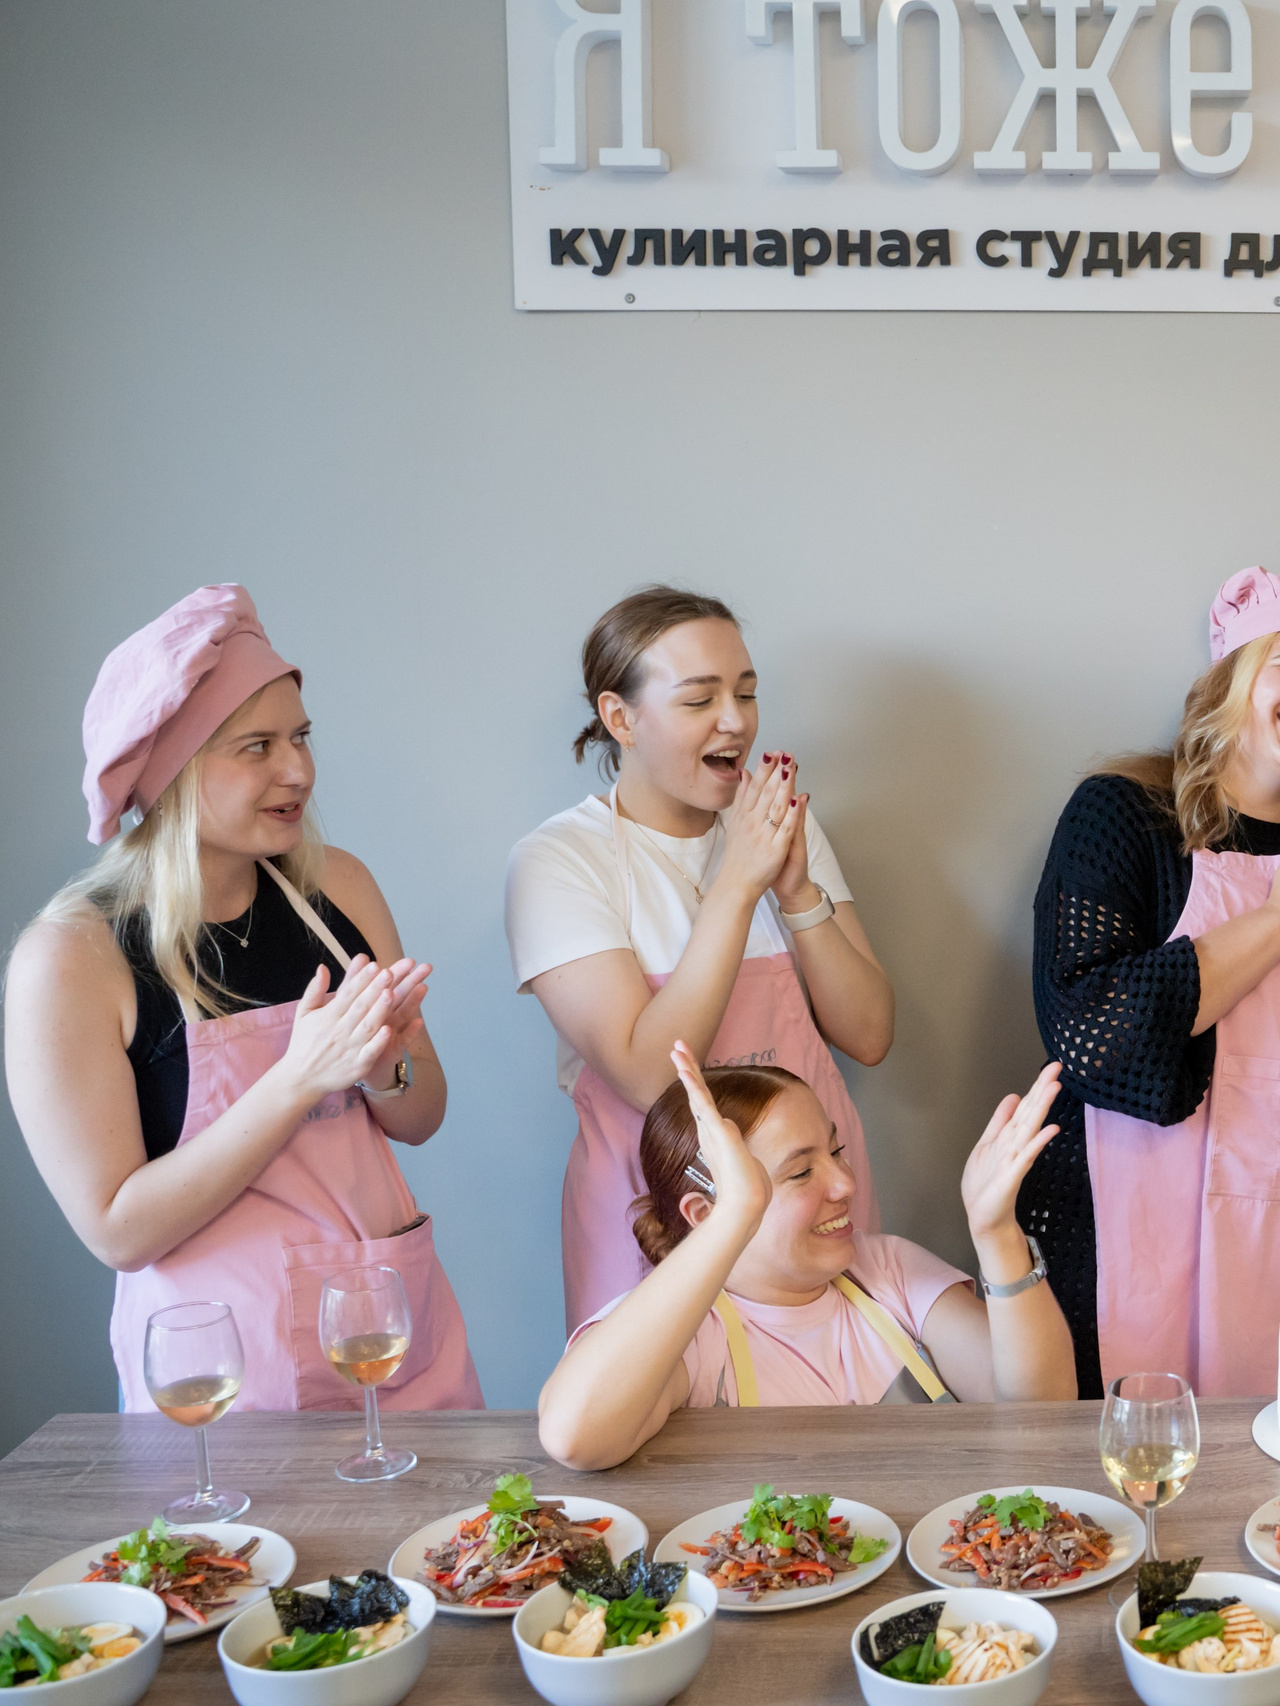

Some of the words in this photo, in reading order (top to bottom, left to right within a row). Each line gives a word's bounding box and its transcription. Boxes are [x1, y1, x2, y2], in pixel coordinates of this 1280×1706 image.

[538, 0, 670, 173] Я
[745, 0, 1253, 179] тоже
[549, 226, 952, 278] кулинарная
[975, 228, 1201, 279] студия
